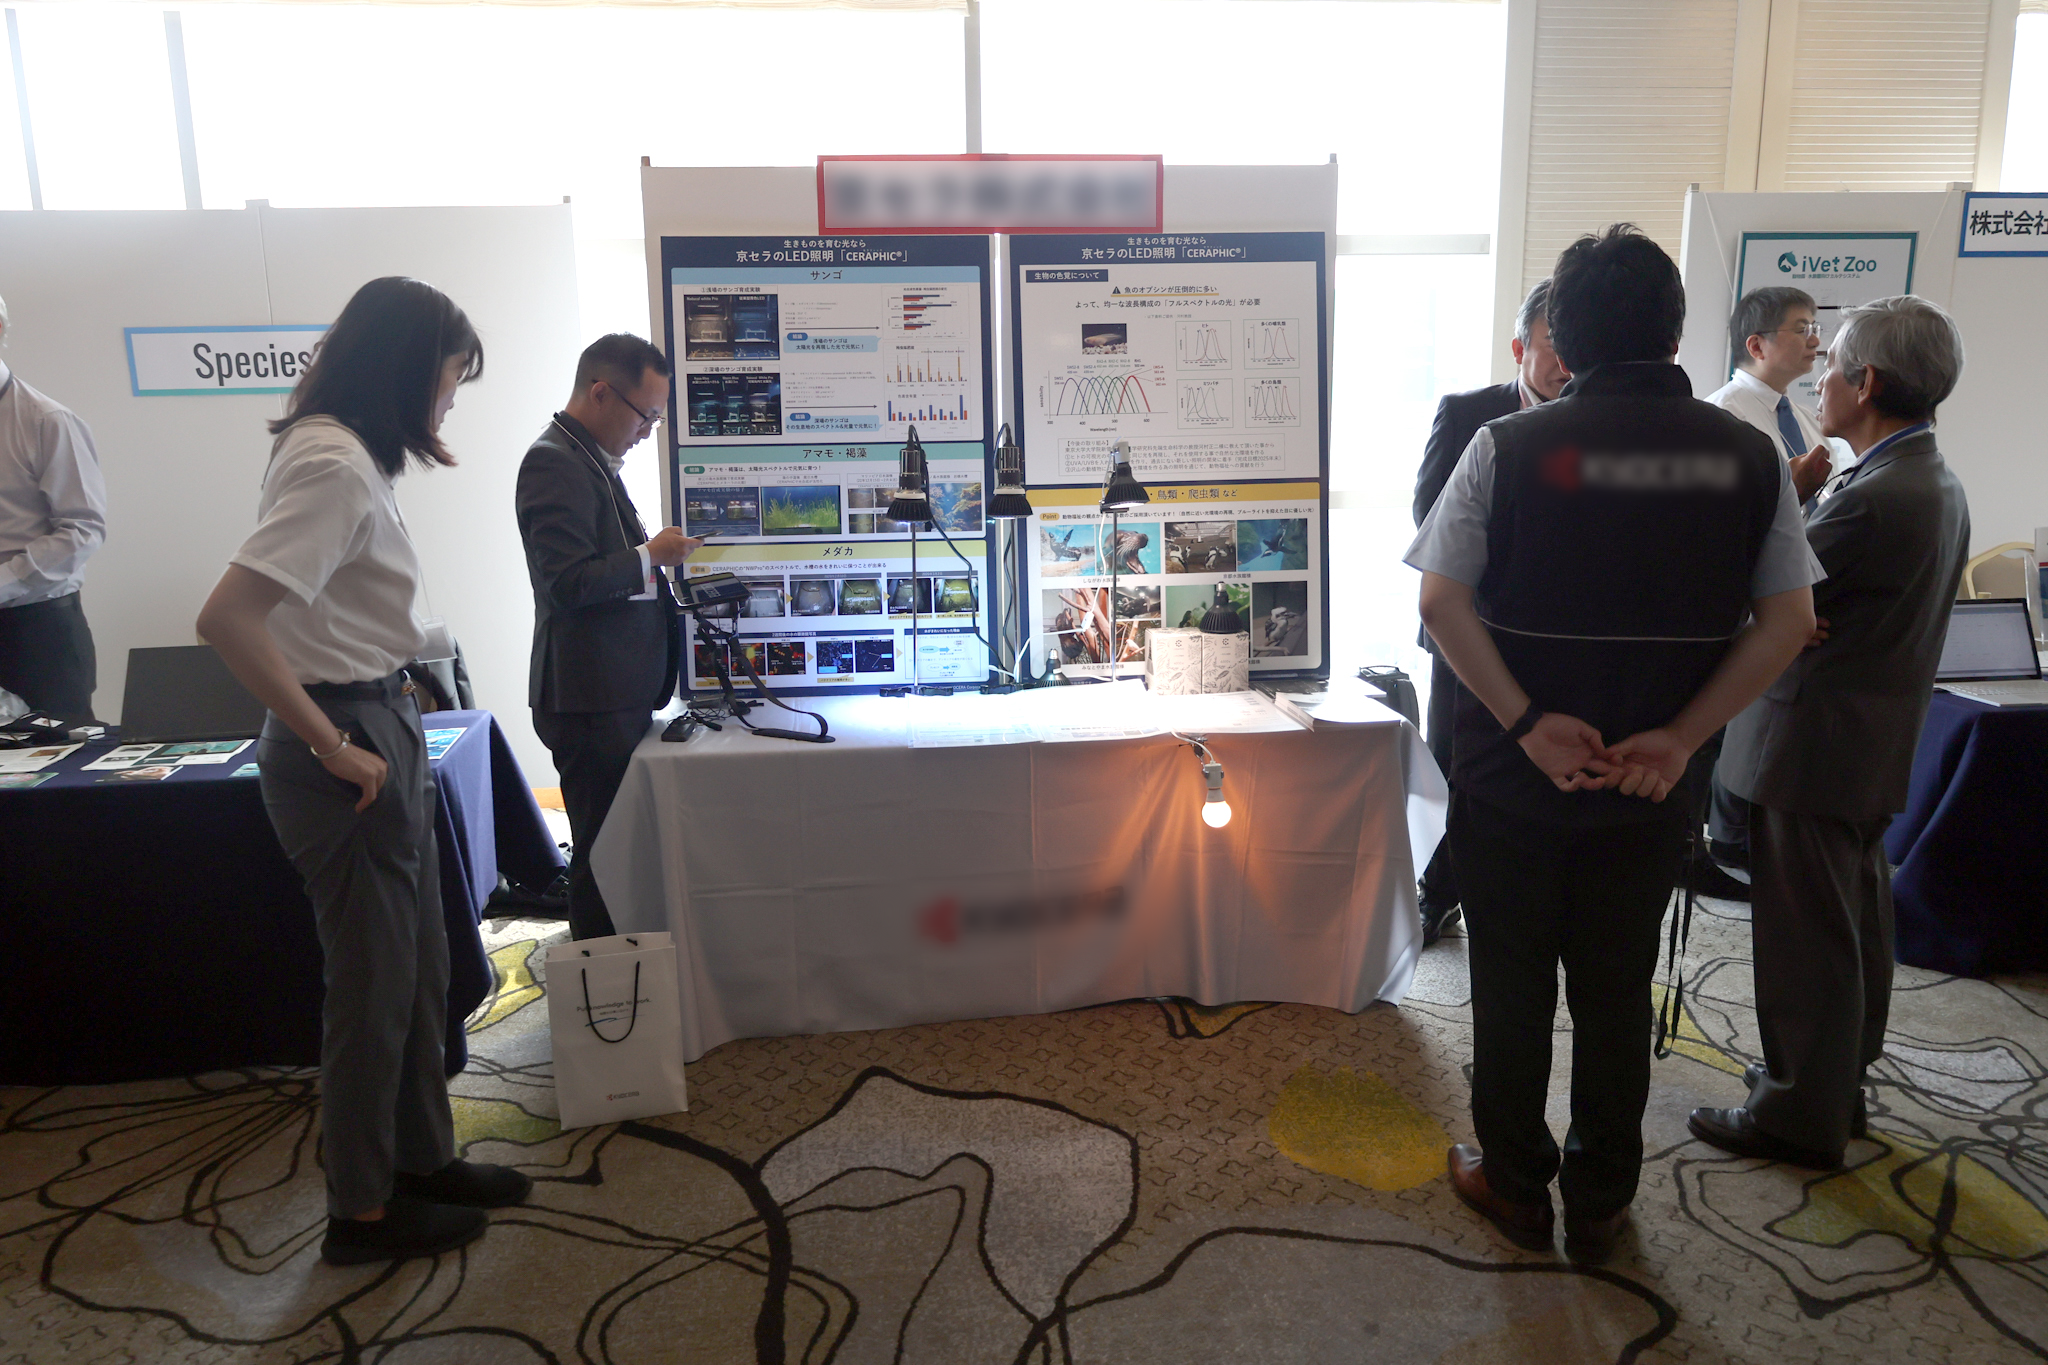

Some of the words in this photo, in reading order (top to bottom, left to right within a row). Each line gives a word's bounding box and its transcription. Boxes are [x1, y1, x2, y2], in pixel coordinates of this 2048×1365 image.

[1970, 210, 2048, 236] 株式会社
[784, 240, 866, 248] 生きものを育む光なら
[1127, 237, 1206, 246] 生きものを育む光なら
[1802, 256, 1840, 272] iVet
[1844, 256, 1877, 272] Zoo
[810, 270, 843, 280] サンゴ
[1034, 272, 1100, 280] 生物の色覚について
[803, 447, 867, 459] アマモ・褐藻
[822, 546, 853, 556] メダカ
[590, 1002, 624, 1010] nowledge
